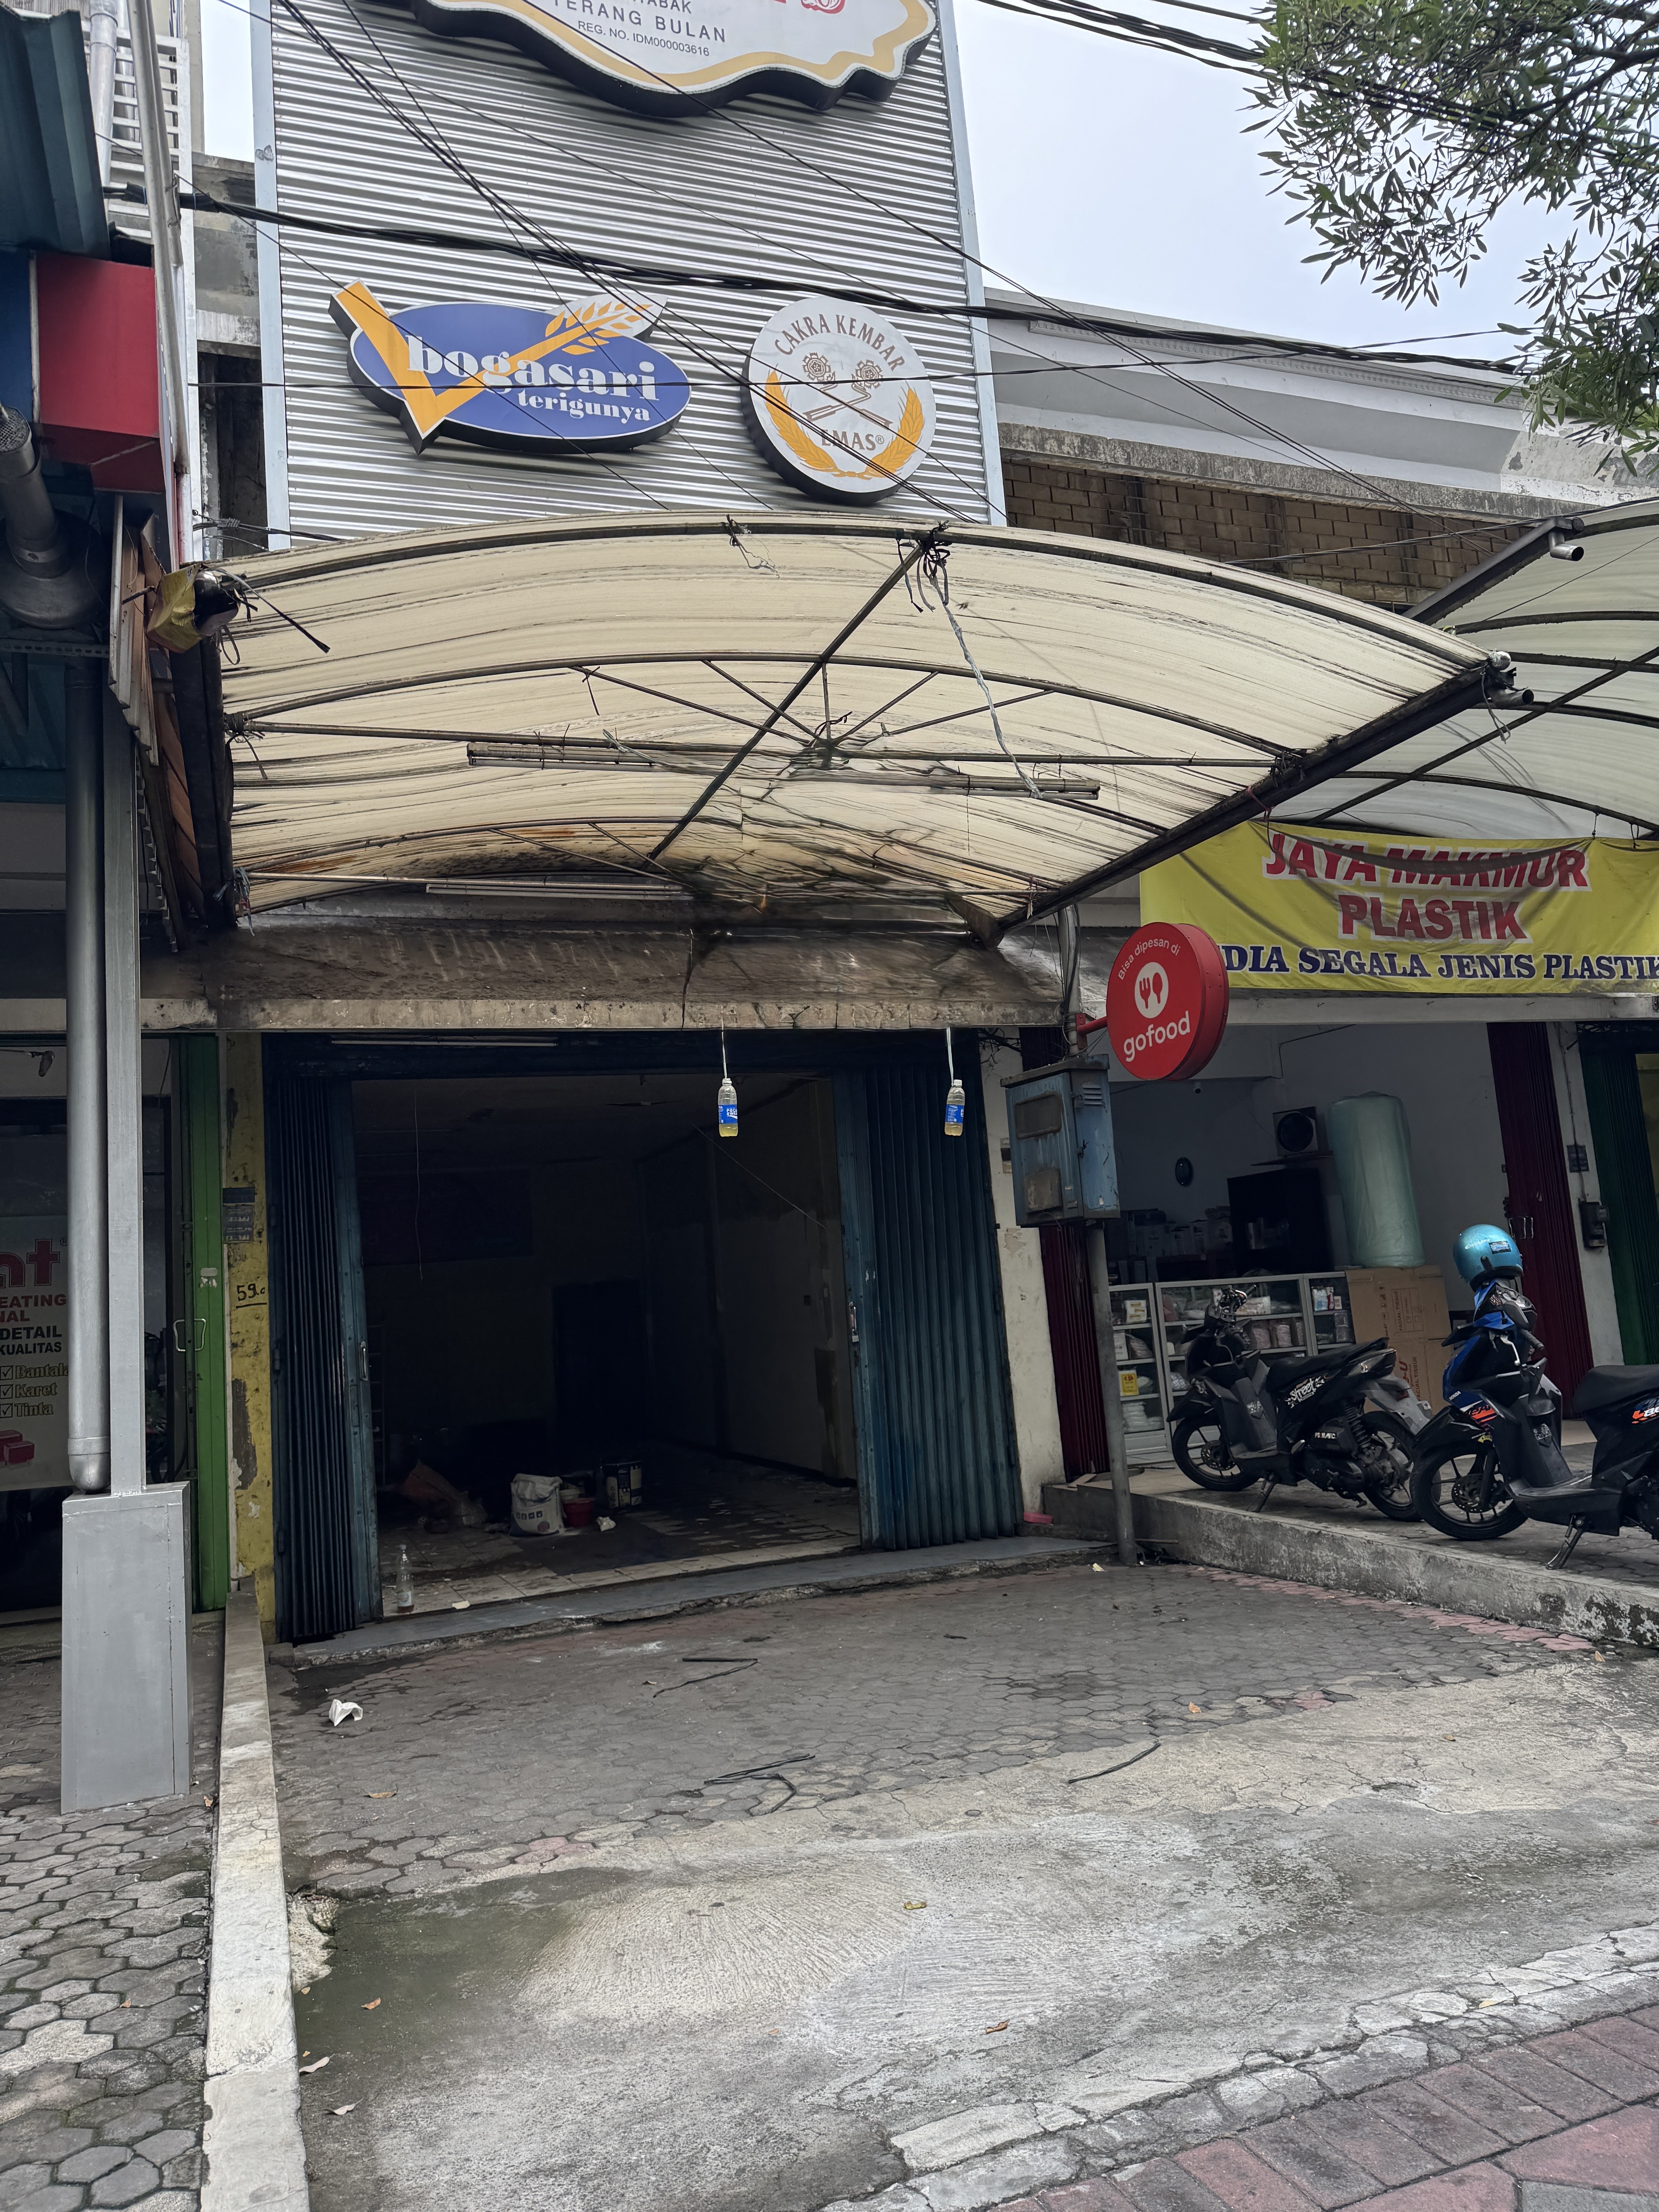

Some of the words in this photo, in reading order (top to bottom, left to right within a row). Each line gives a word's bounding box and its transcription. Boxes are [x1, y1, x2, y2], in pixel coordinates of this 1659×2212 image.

[578, 20, 606, 35] REG.
[609, 27, 630, 41] NO.
[633, 33, 710, 57] IDM000003616
[655, 15, 725, 43] BULAN
[775, 313, 831, 356] CAKRA
[835, 314, 905, 372] KEMBAR
[405, 333, 659, 401] bogasari
[517, 390, 651, 424] terigunya
[1266, 833, 1377, 882] JAYA
[1386, 847, 1589, 888] MAKMUR
[1338, 894, 1528, 939] PLASTIK
[1118, 954, 1134, 981] Bisa
[1134, 938, 1170, 956] dipesan
[1171, 943, 1181, 956] di
[1219, 945, 1290, 972] DIA
[1298, 946, 1432, 977] SEGALA
[1437, 954, 1536, 979] JENIS
[1123, 1010, 1191, 1063] gofood
[0, 1325, 62, 1340] DETAIL
[15, 1382, 57, 1398] Karet
[1448, 1391, 1462, 1401] HONDA
[14, 1402, 54, 1417] Tinta
